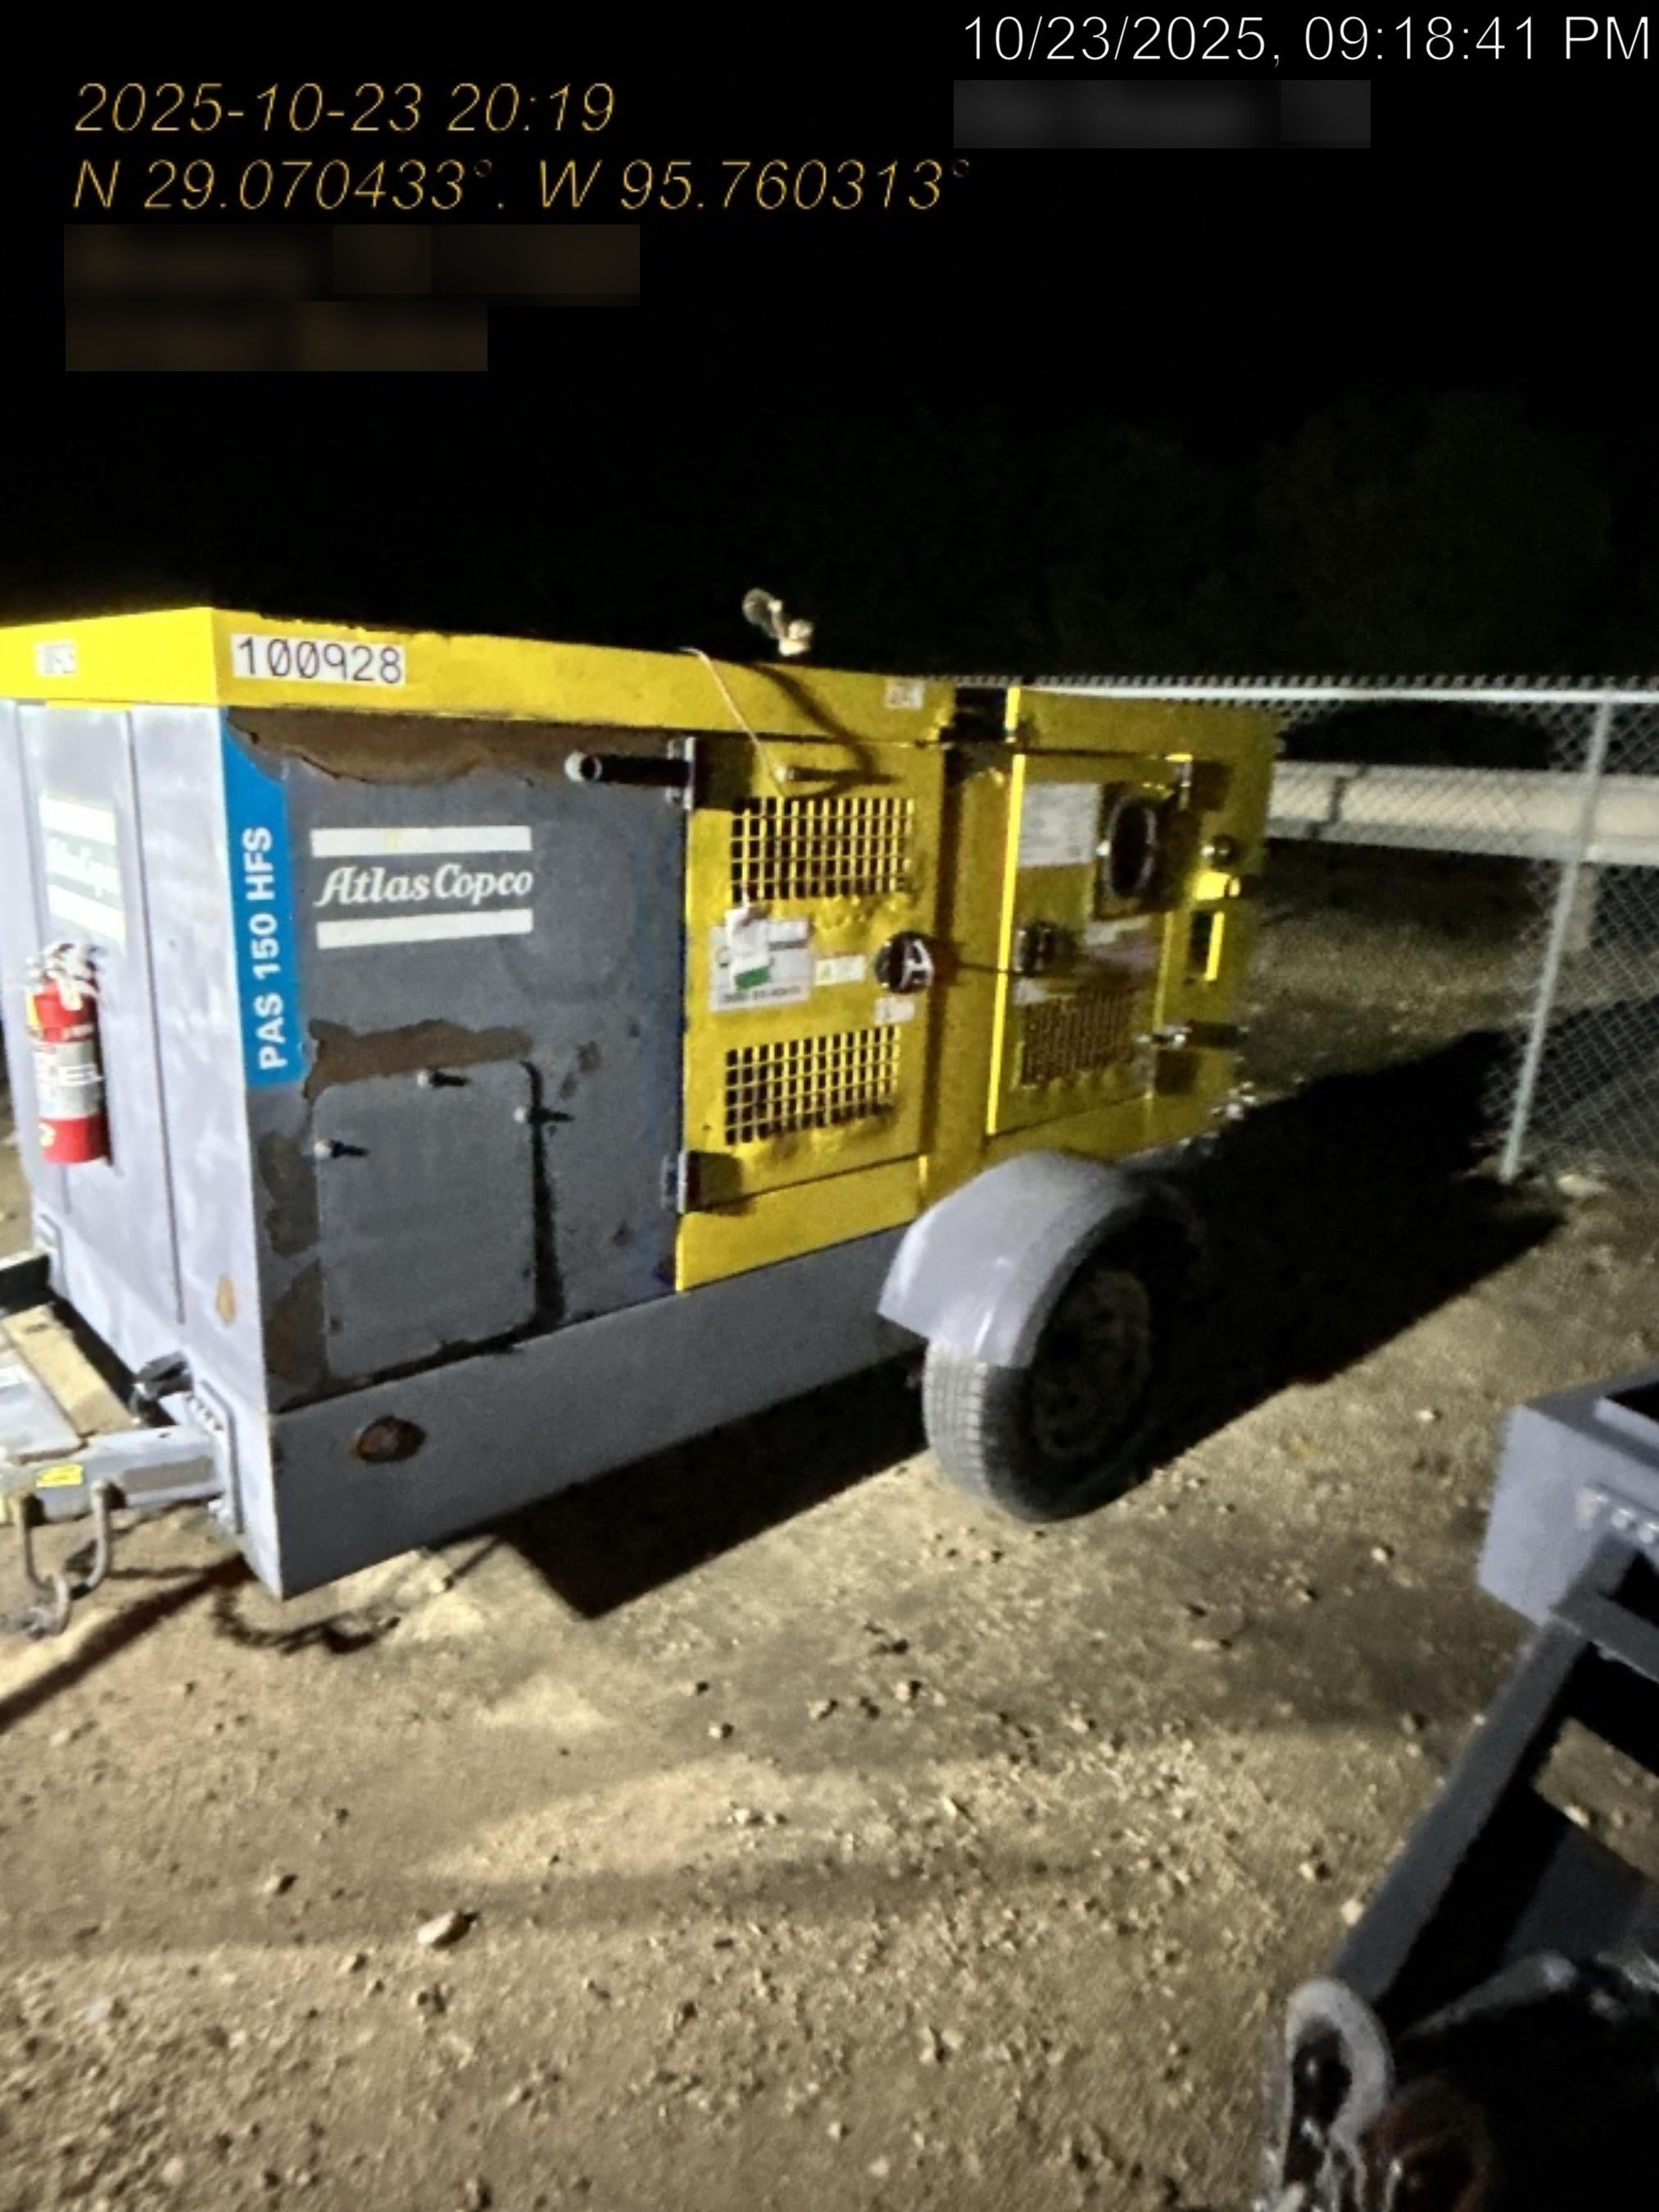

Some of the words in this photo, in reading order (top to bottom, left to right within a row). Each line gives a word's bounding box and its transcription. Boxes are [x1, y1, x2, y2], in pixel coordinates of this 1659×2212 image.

[238, 637, 401, 683] 100928
[242, 827, 275, 900] HFS
[313, 865, 431, 907] Atlas
[433, 863, 533, 905] Copco
[249, 913, 281, 981] 150
[253, 992, 288, 1070] PAS
